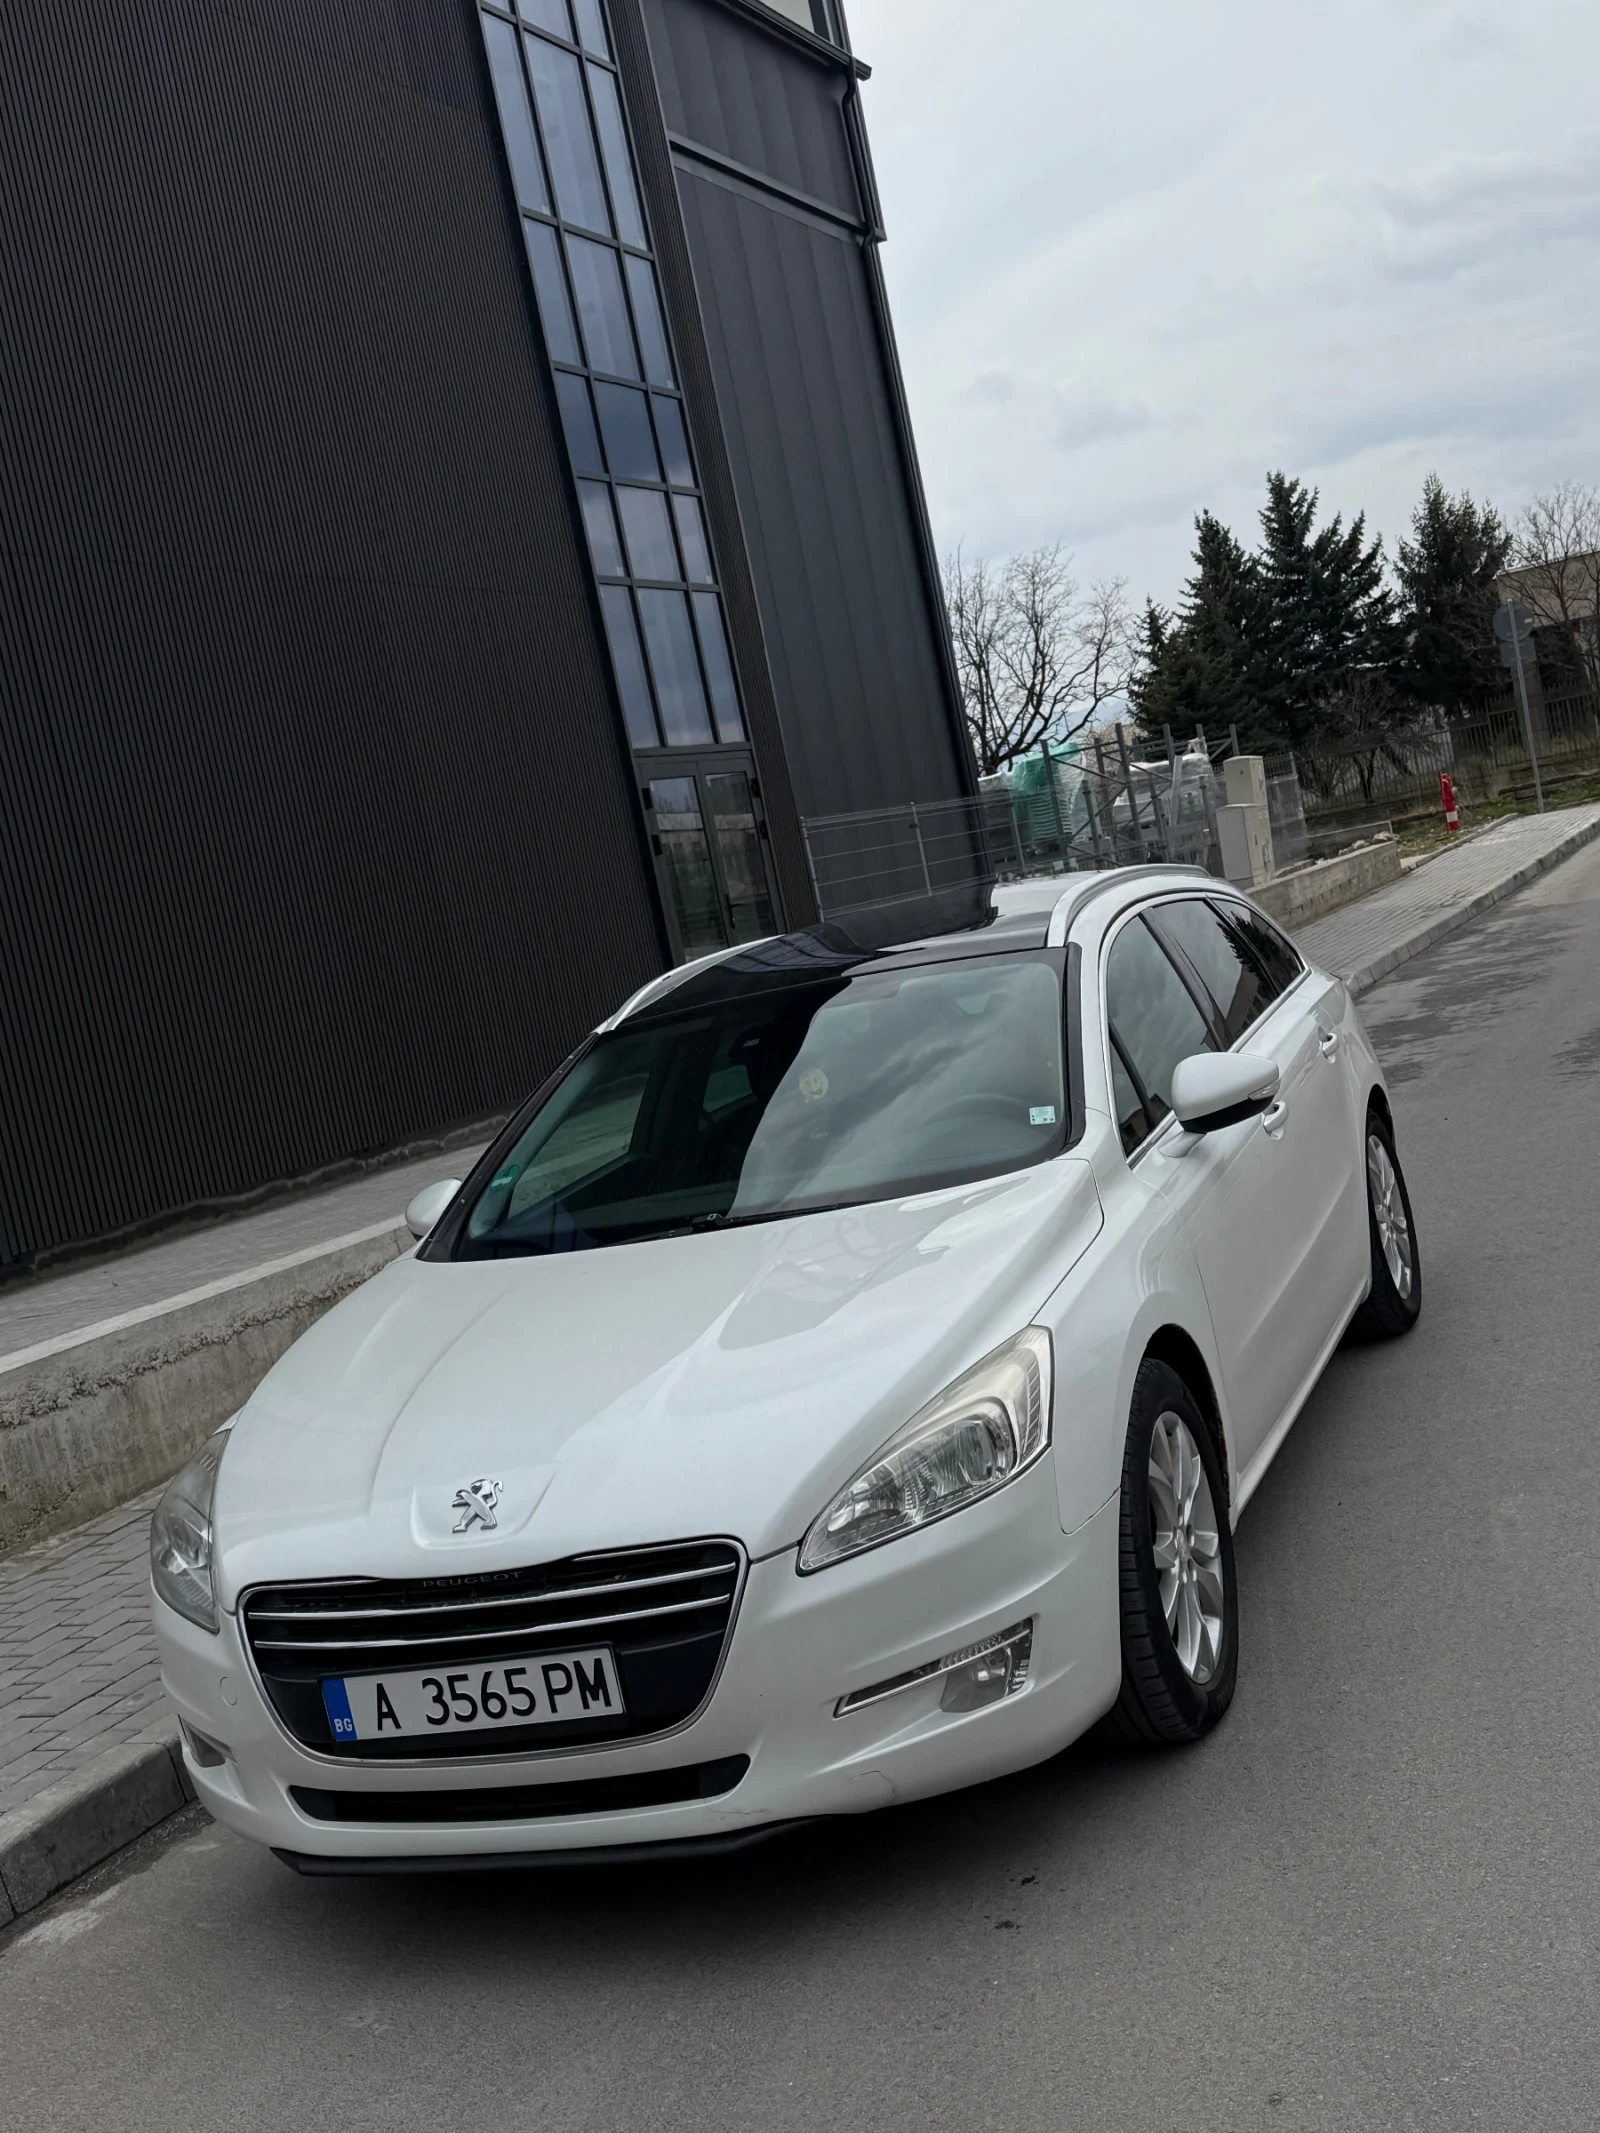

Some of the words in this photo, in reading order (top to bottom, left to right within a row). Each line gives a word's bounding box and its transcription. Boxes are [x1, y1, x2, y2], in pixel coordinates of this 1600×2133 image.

[422, 1571, 523, 1588] PEUGEOT
[376, 1682, 402, 1731] A
[421, 1667, 536, 1726] 3565
[541, 1657, 613, 1714] PM
[334, 1717, 353, 1733] BG
